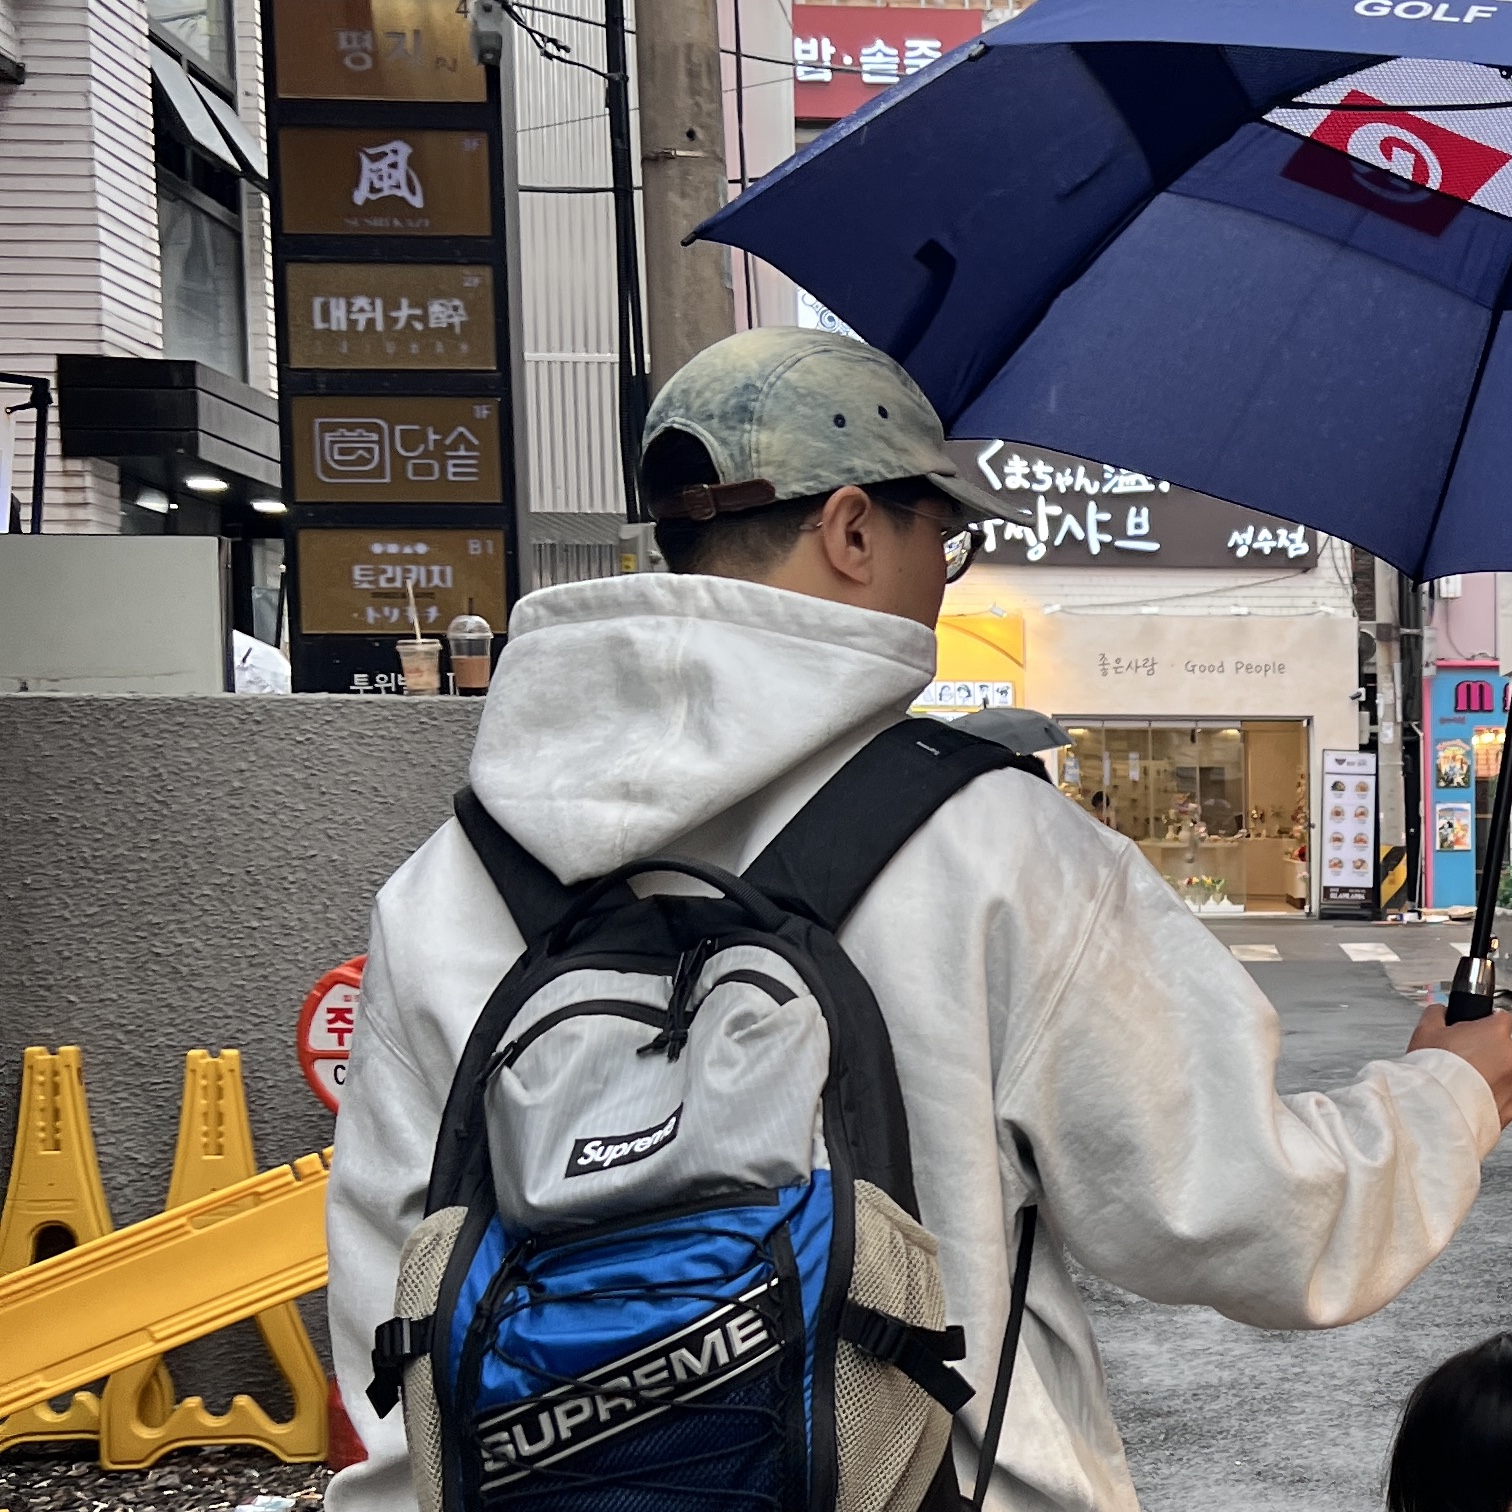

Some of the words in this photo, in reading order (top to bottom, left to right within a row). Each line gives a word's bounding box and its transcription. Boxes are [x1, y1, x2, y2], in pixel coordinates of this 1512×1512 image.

[1353, 0, 1498, 24] GOLF
[467, 539, 494, 556] B1
[1227, 524, 1310, 559] 성수점
[1184, 660, 1226, 674] Good
[1234, 660, 1287, 677] People
[480, 1307, 769, 1472] SUPREME
